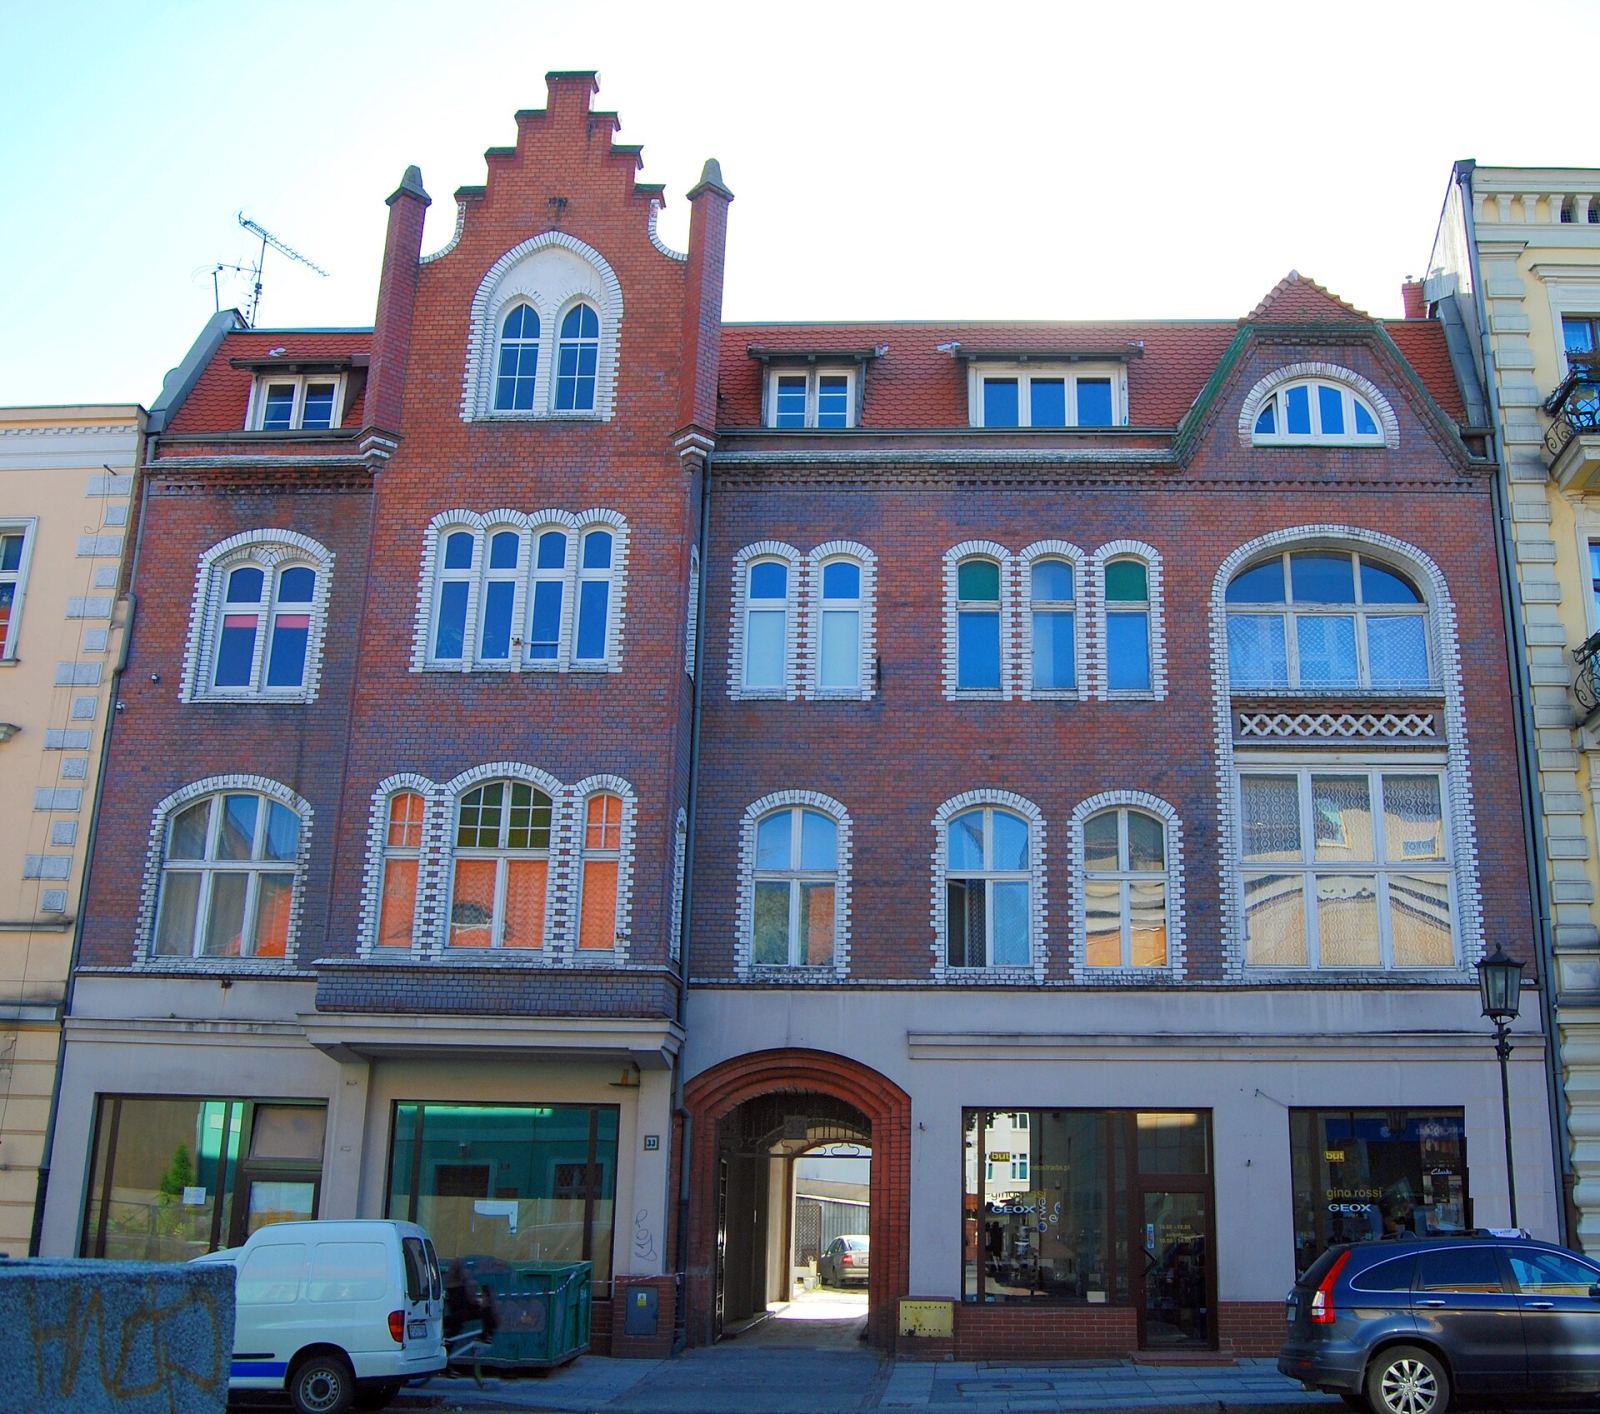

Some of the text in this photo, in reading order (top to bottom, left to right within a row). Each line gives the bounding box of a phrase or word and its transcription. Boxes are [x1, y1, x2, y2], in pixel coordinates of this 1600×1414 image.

[1326, 1151, 1344, 1160] but
[1354, 1187, 1382, 1198] rossi
[992, 1205, 1037, 1214] GEOX
[1328, 1204, 1372, 1212] GEOX
